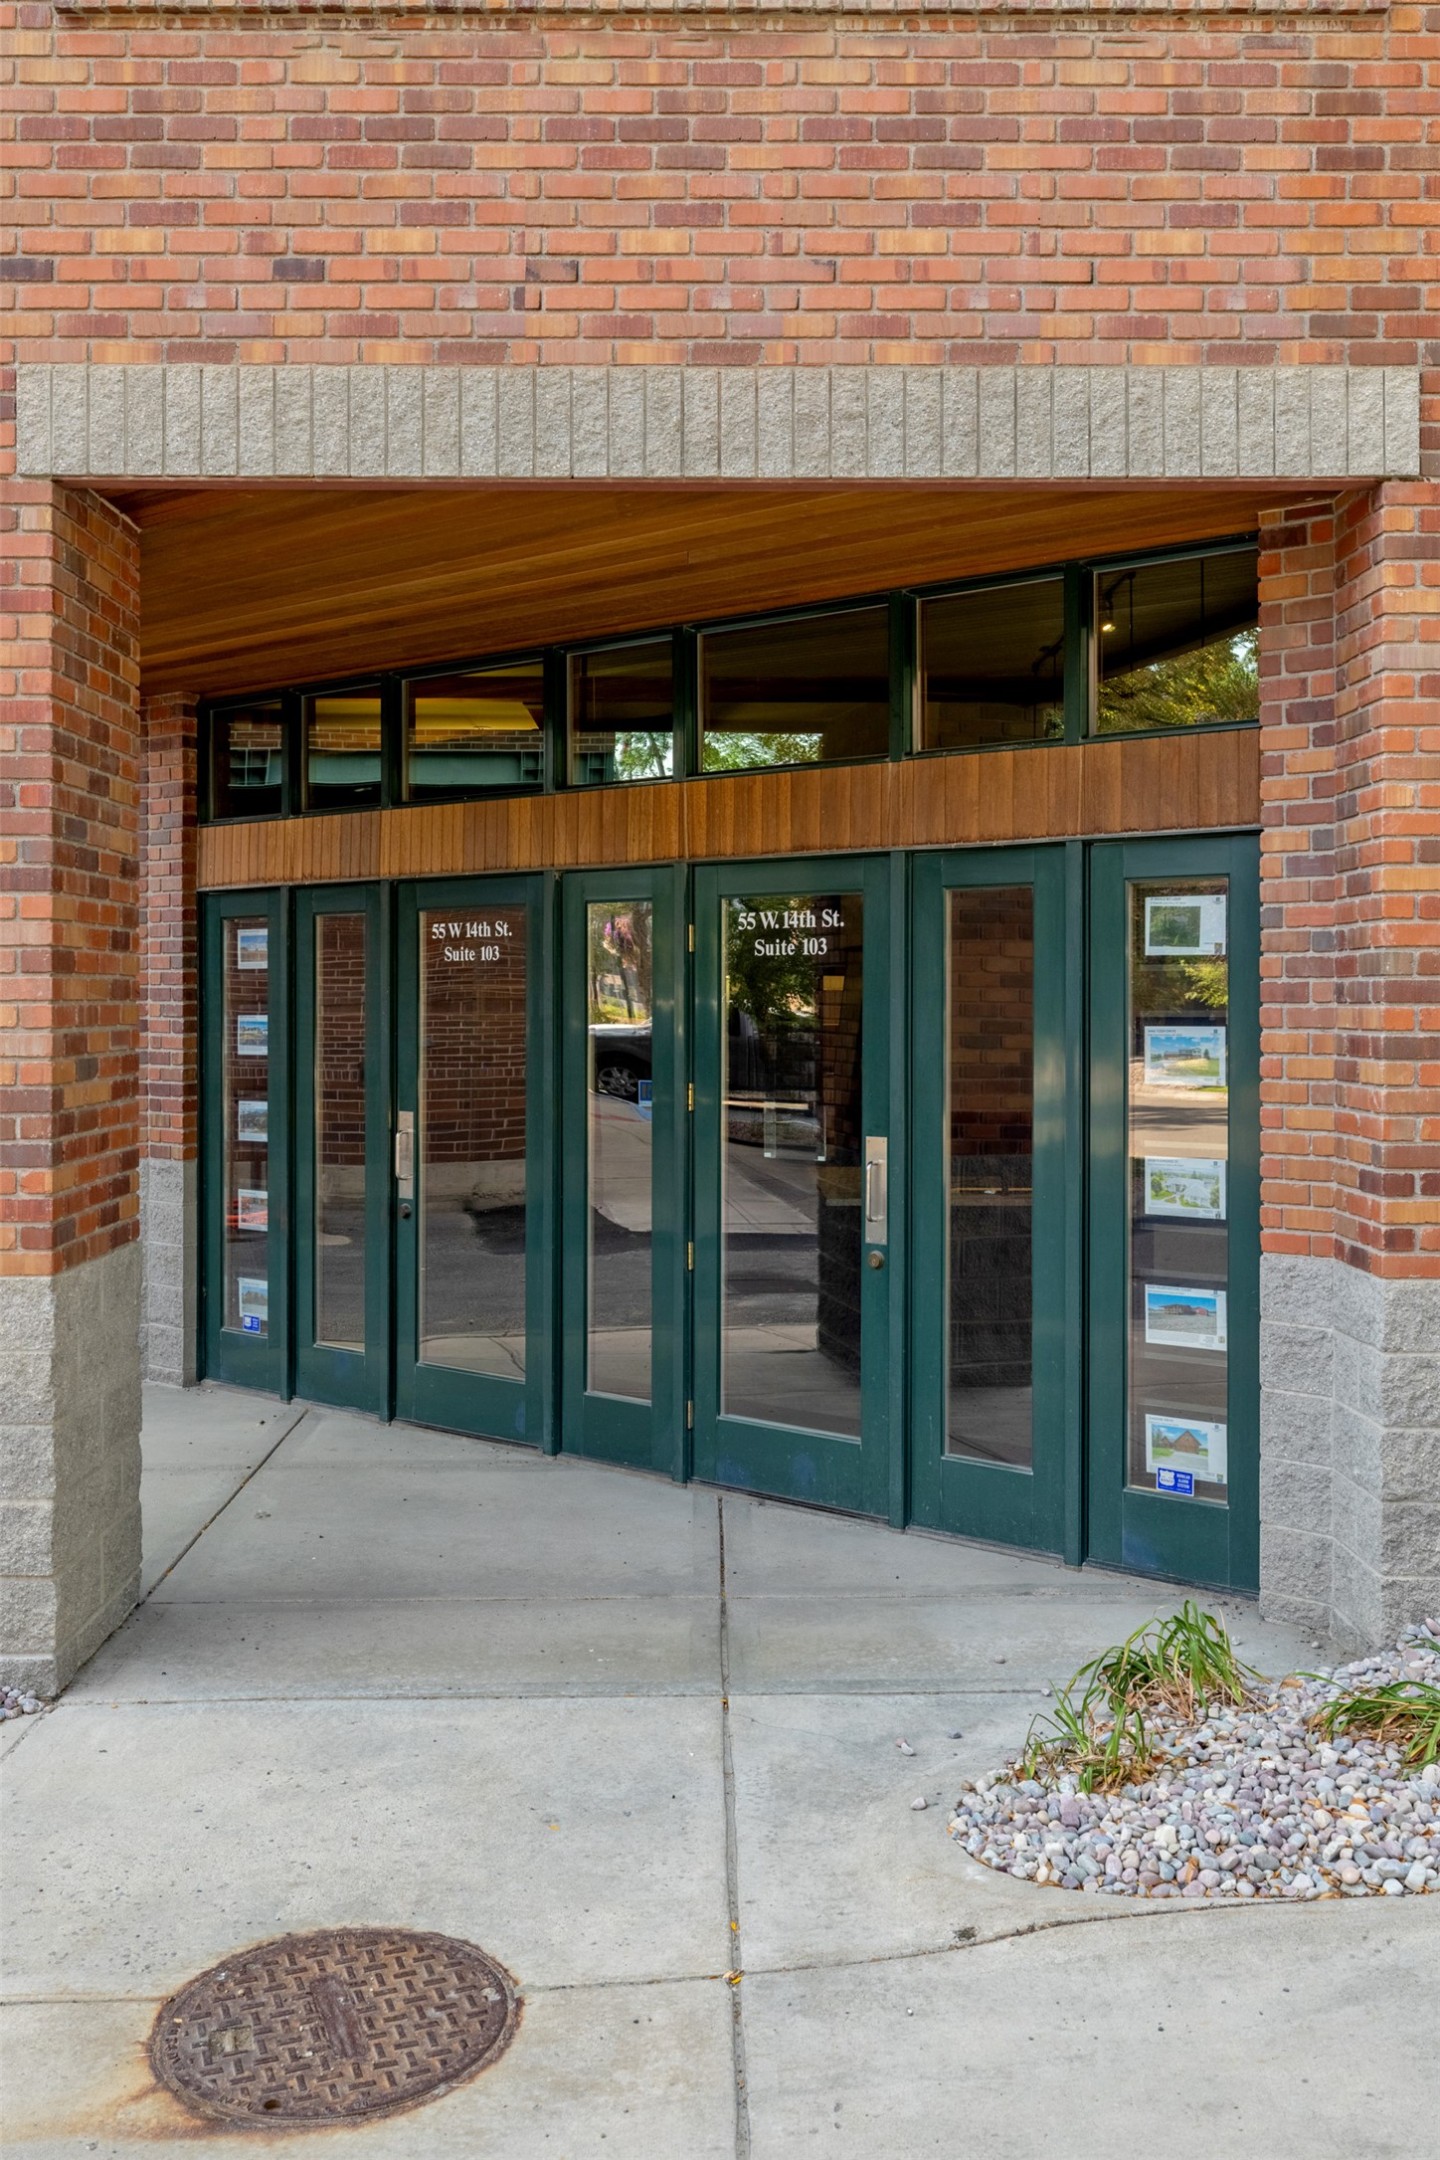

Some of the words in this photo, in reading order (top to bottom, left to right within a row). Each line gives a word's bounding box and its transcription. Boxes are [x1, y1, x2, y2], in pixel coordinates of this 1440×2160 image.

[738, 912, 757, 930] 55
[759, 911, 780, 929] W.
[782, 910, 817, 929] 14th
[821, 909, 845, 928] St.
[432, 924, 446, 939] 55
[448, 922, 463, 938] W
[465, 921, 491, 938] 14th
[495, 920, 513, 936] St.
[444, 946, 476, 962] Suite
[480, 945, 500, 961] 103
[754, 939, 796, 956] Suite
[802, 938, 828, 956] 103
